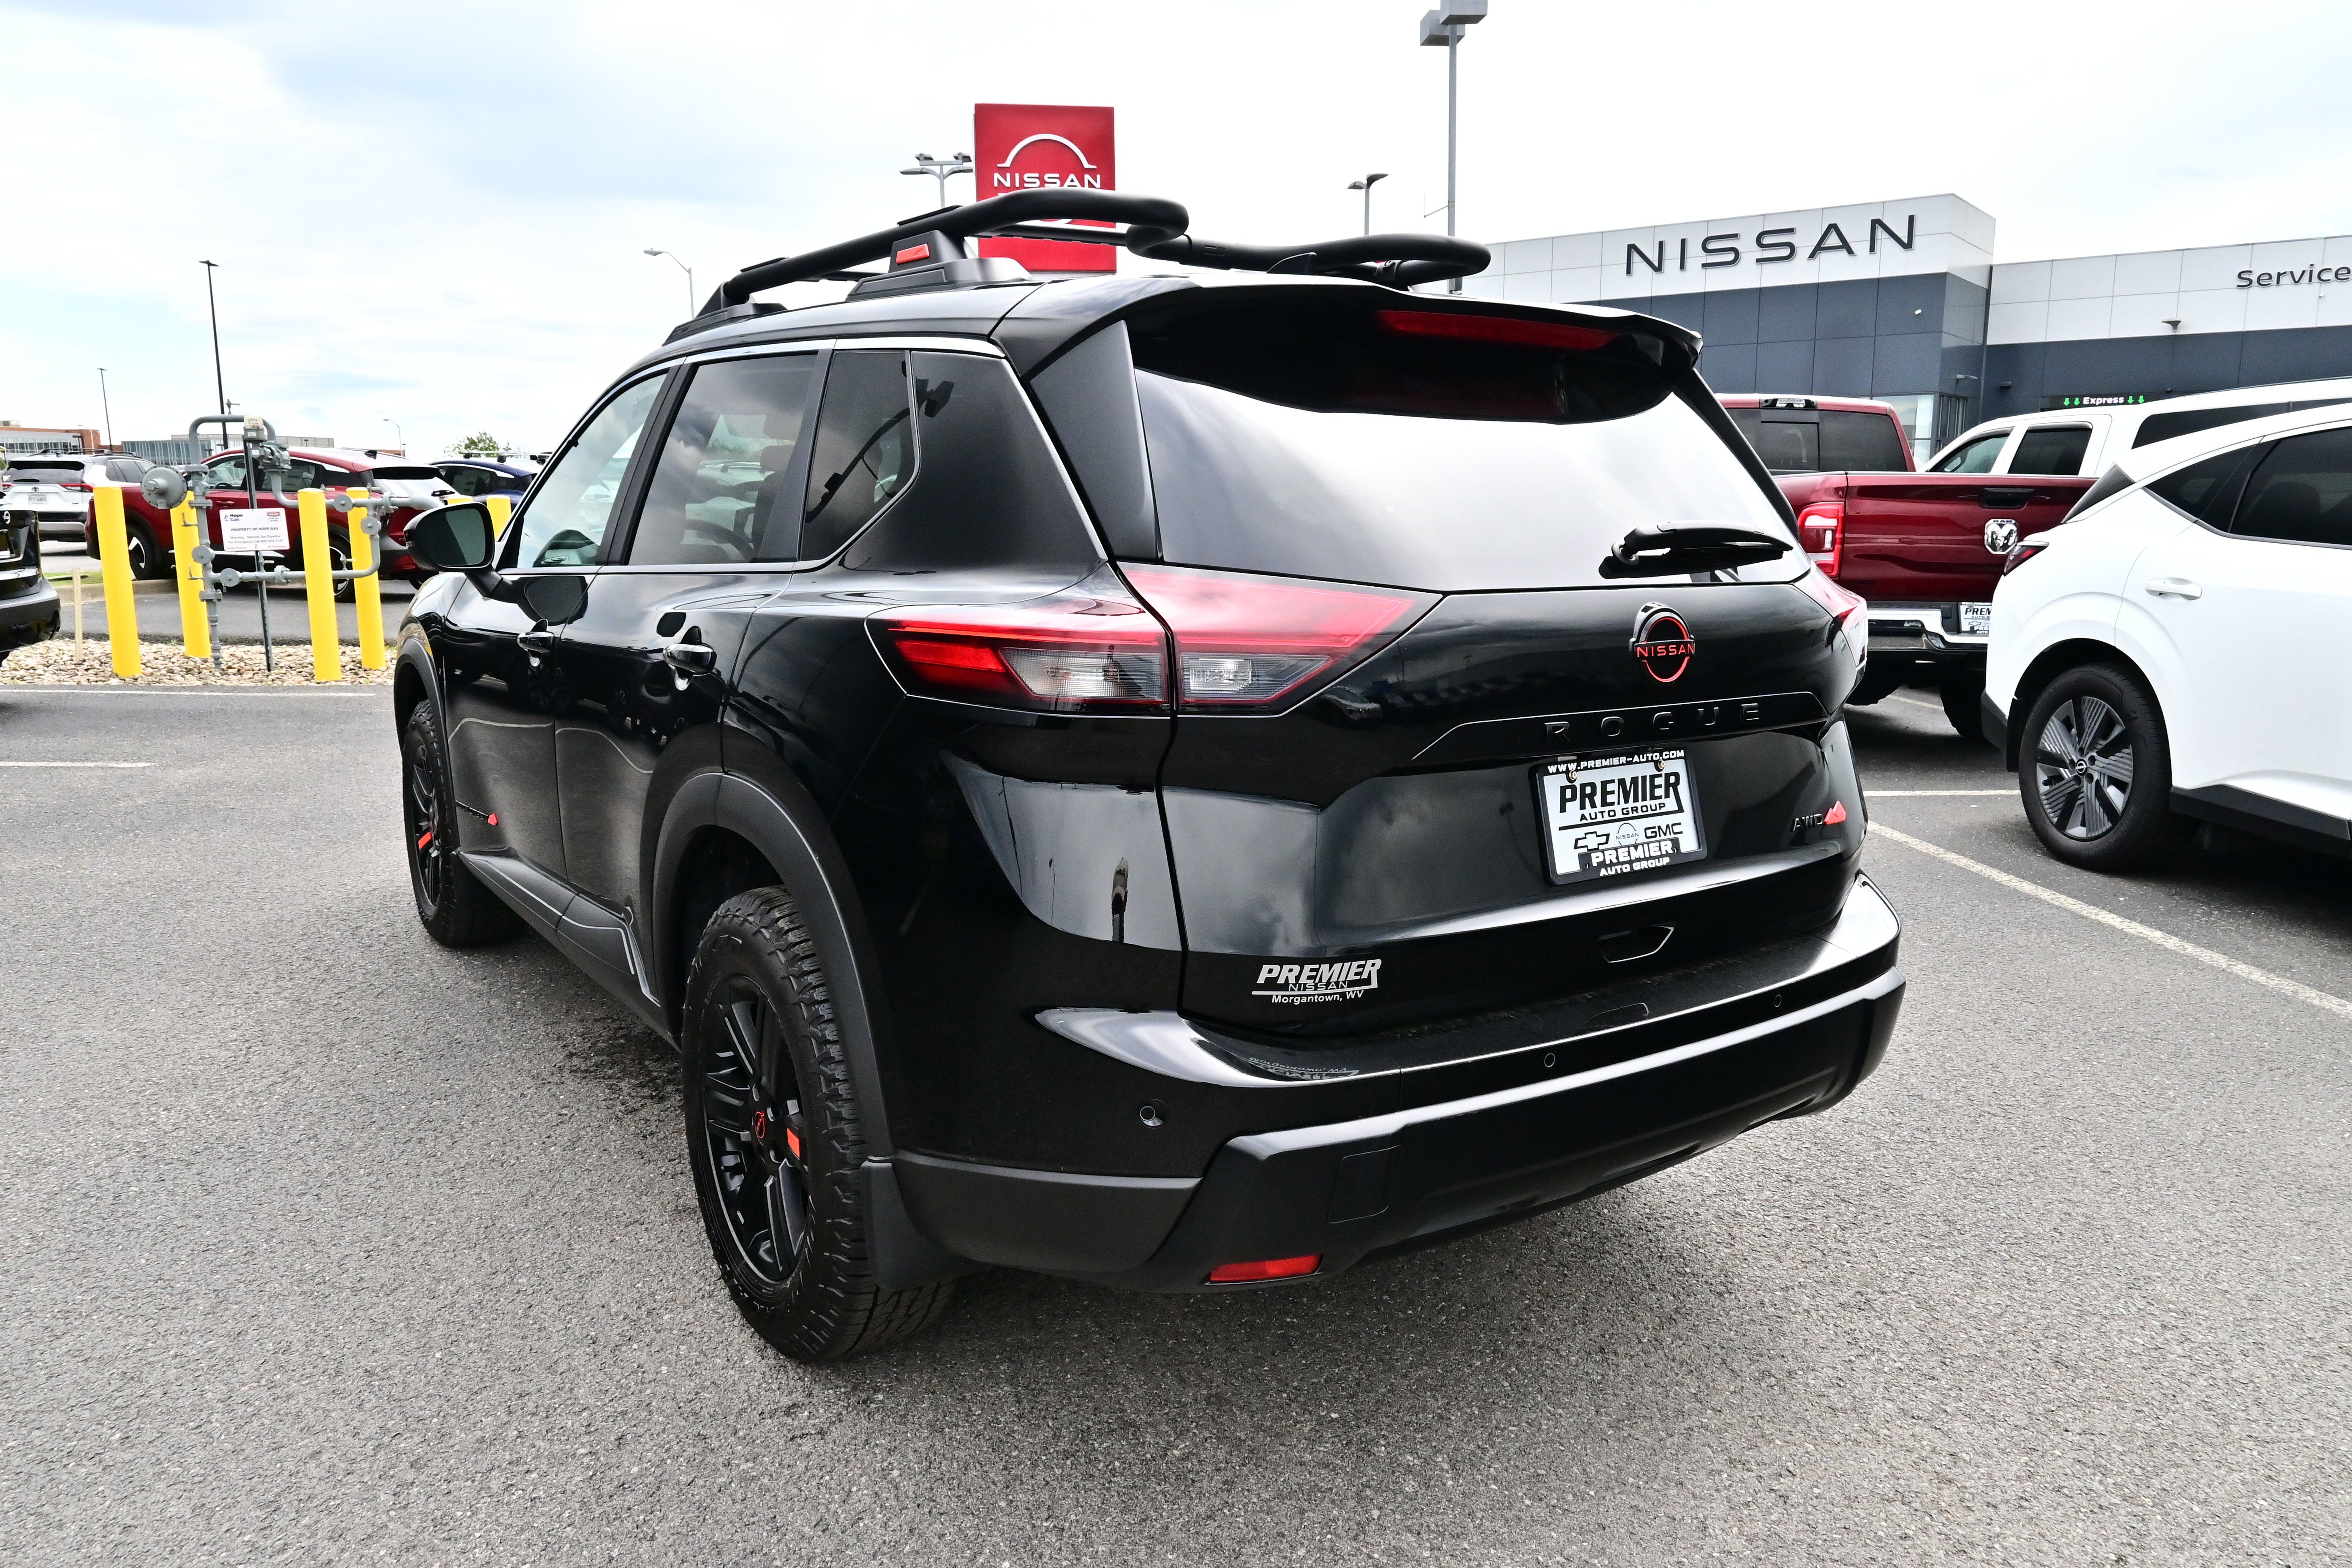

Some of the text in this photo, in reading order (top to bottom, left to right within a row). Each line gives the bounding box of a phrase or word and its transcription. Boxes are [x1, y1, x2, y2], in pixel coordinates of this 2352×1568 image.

[994, 173, 1101, 188] NISSAN
[1626, 214, 1915, 276] NISSAN
[2237, 263, 2352, 288] Service
[2083, 397, 2124, 406] Express
[1637, 644, 1695, 657] NISSAN
[1544, 703, 1760, 744] ROGUE
[1548, 750, 1685, 773] WWW.PREMIER-AUTO.COM
[1560, 771, 1685, 813] PREMIER
[1580, 802, 1666, 822] AUTO GROUP
[1616, 822, 1683, 840] NISSAN GMC
[1790, 814, 1824, 832] AWD
[1591, 840, 1674, 867] PREMIER
[1600, 857, 1670, 877] AUTO GROUP
[1256, 959, 1382, 985] PREMIER
[1288, 980, 1348, 991] NISSAN
[1271, 990, 1364, 1005] Morgantown, WV
